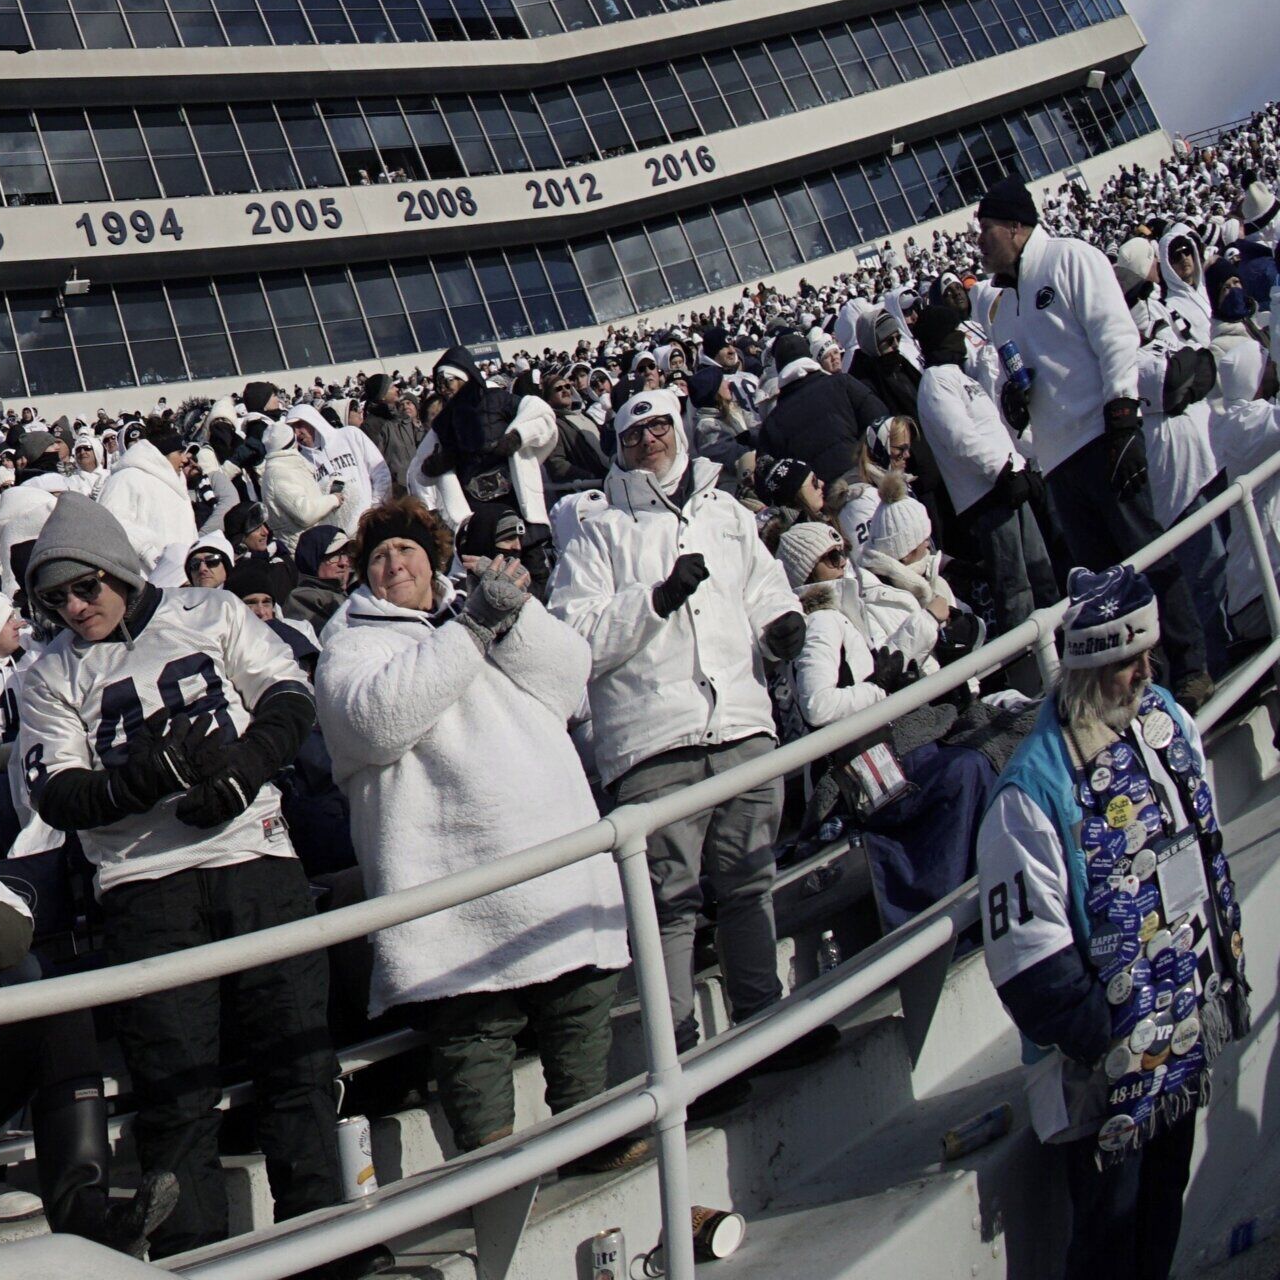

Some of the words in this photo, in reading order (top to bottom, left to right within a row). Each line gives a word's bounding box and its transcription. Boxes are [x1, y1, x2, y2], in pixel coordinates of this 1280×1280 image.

[644, 145, 716, 187] 2016
[396, 186, 478, 223] 2008
[525, 172, 603, 210] 2012
[75, 207, 184, 247] 1994
[245, 197, 343, 236] 2005
[988, 870, 1035, 942] 81
[1156, 1024, 1174, 1040] VP
[1109, 1081, 1143, 1105] 48-14
